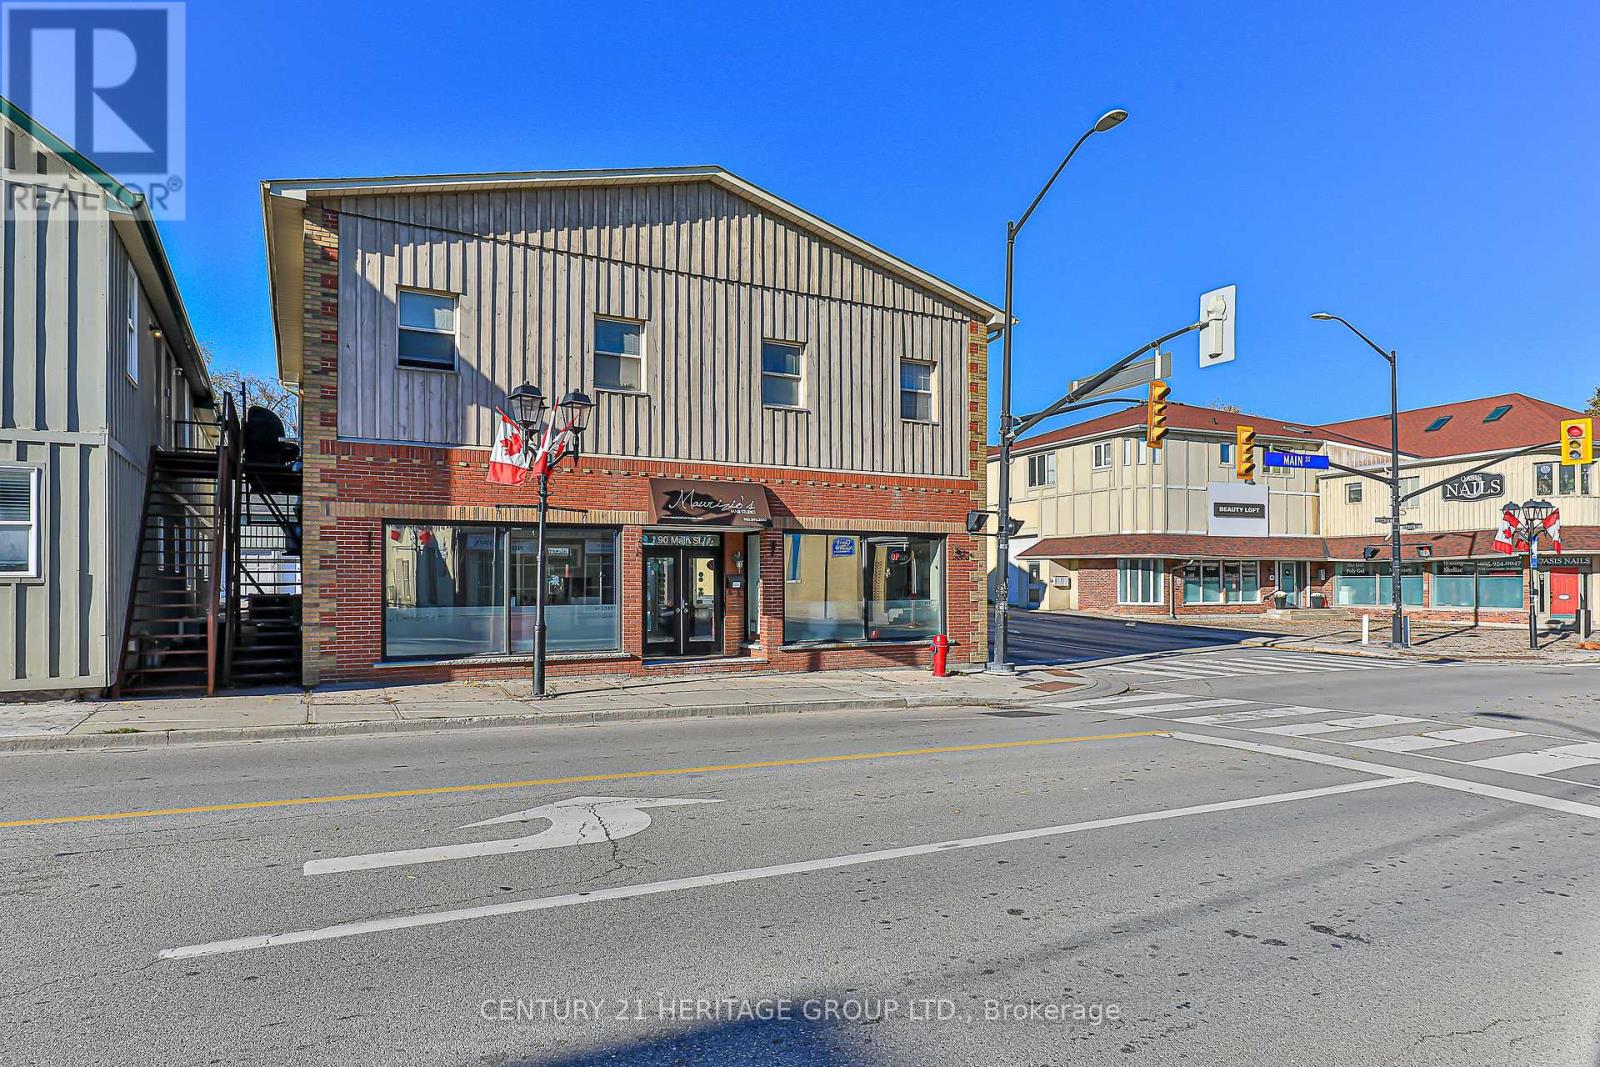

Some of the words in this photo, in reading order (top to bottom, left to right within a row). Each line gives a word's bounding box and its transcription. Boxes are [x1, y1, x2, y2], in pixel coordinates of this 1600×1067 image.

[1283, 454, 1303, 467] MAIN
[1460, 473, 1483, 484] OASIS
[1445, 479, 1501, 498] NAILS
[670, 535, 692, 545] Main
